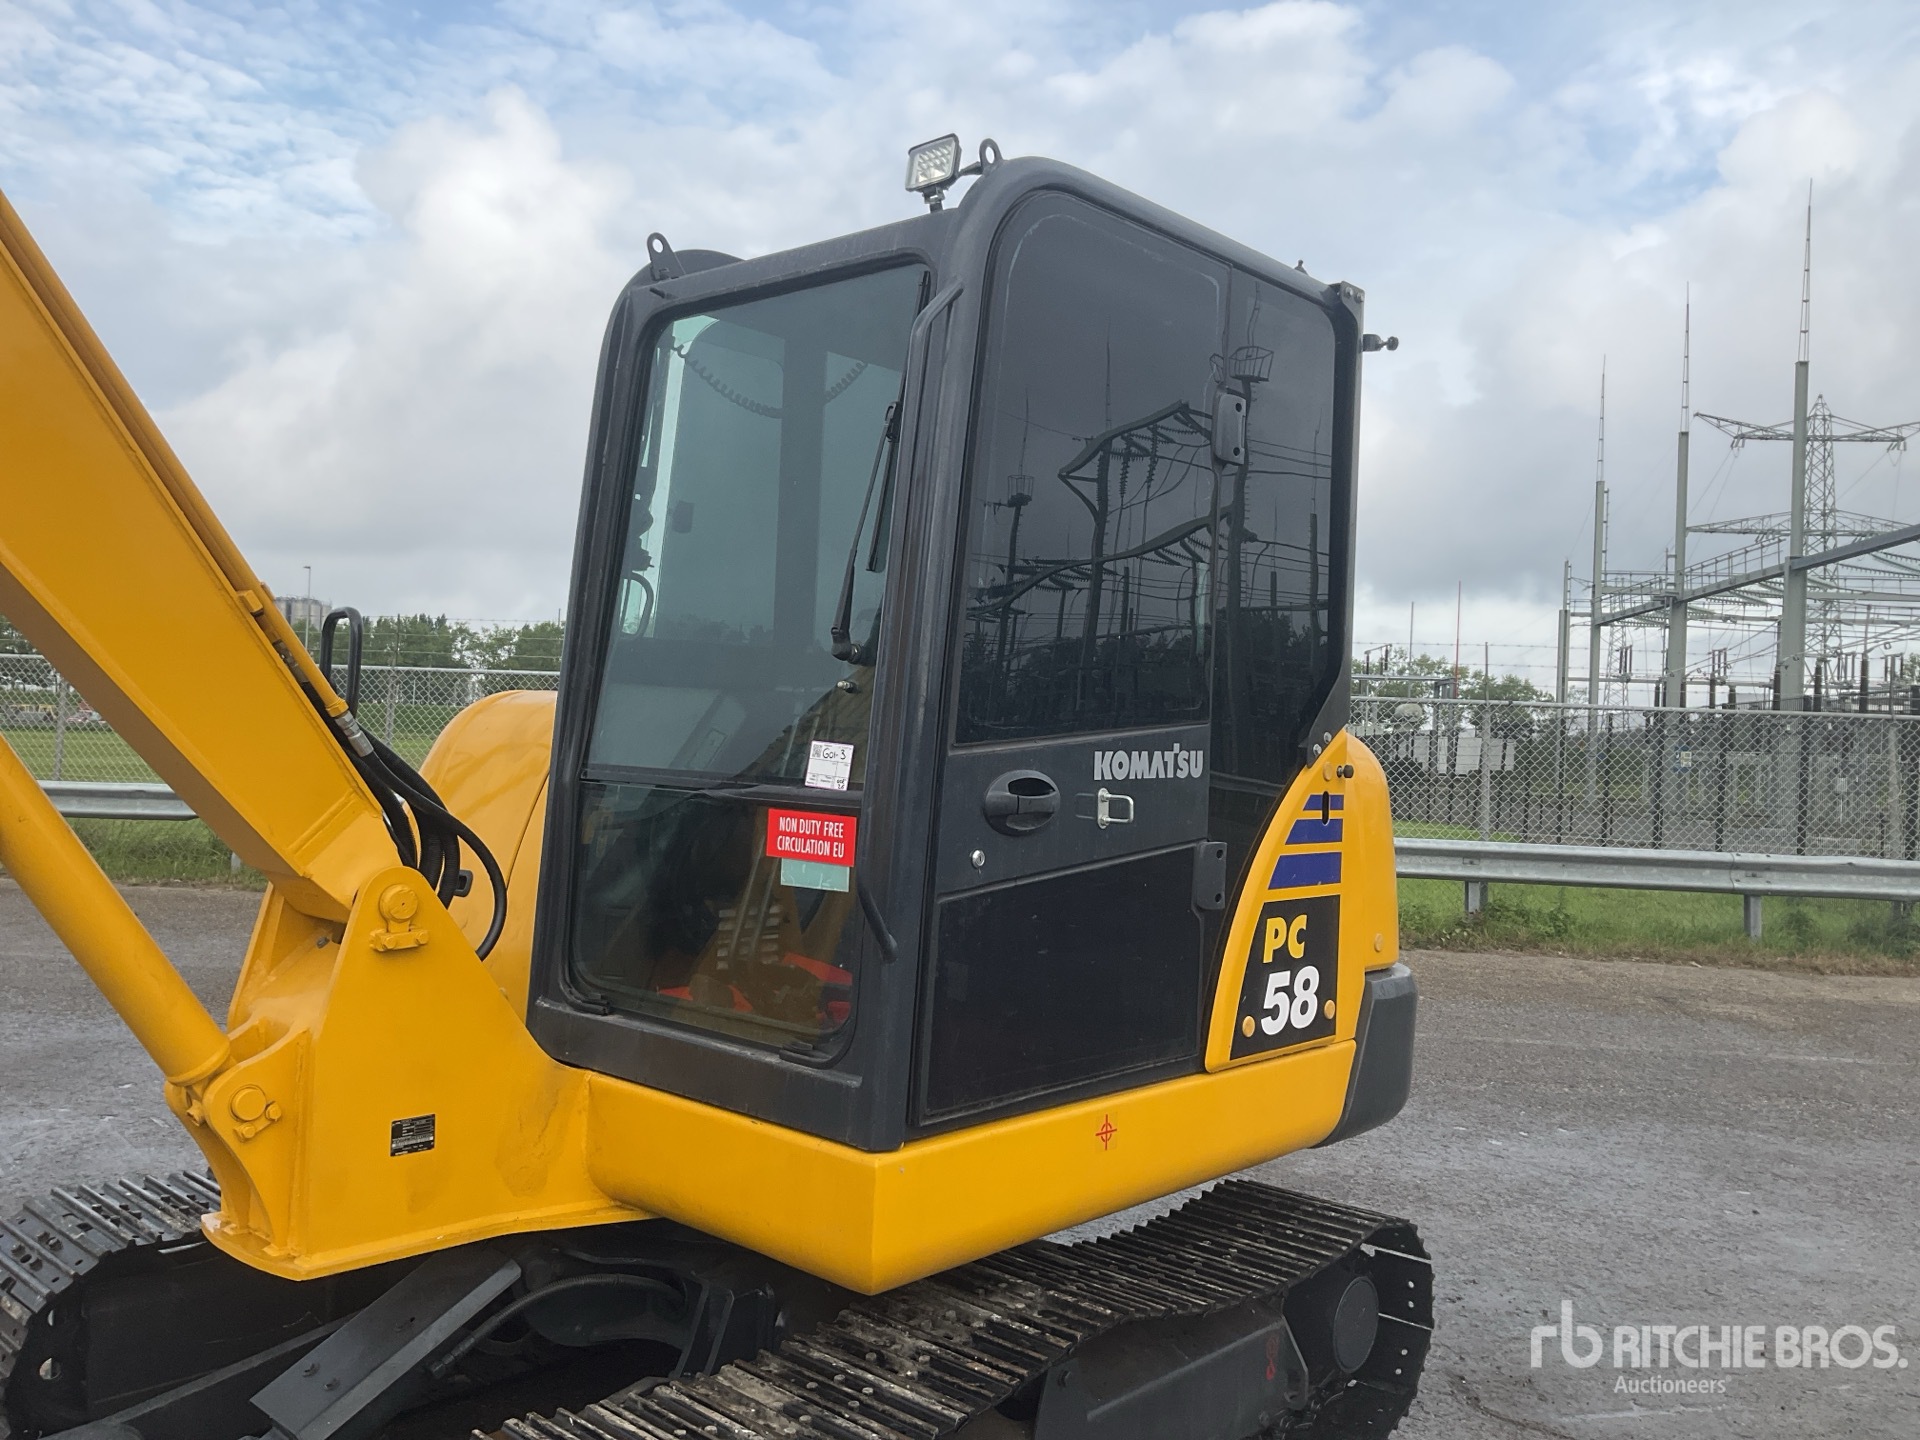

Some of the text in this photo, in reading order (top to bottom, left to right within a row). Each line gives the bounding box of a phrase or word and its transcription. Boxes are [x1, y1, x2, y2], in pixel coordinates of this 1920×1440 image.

[1093, 742, 1204, 780] KOMATSU
[777, 835, 845, 858] CIRCULATION EU
[779, 816, 844, 839] NON DUTY FREE
[1263, 914, 1308, 964] PC
[1261, 965, 1320, 1036] 58
